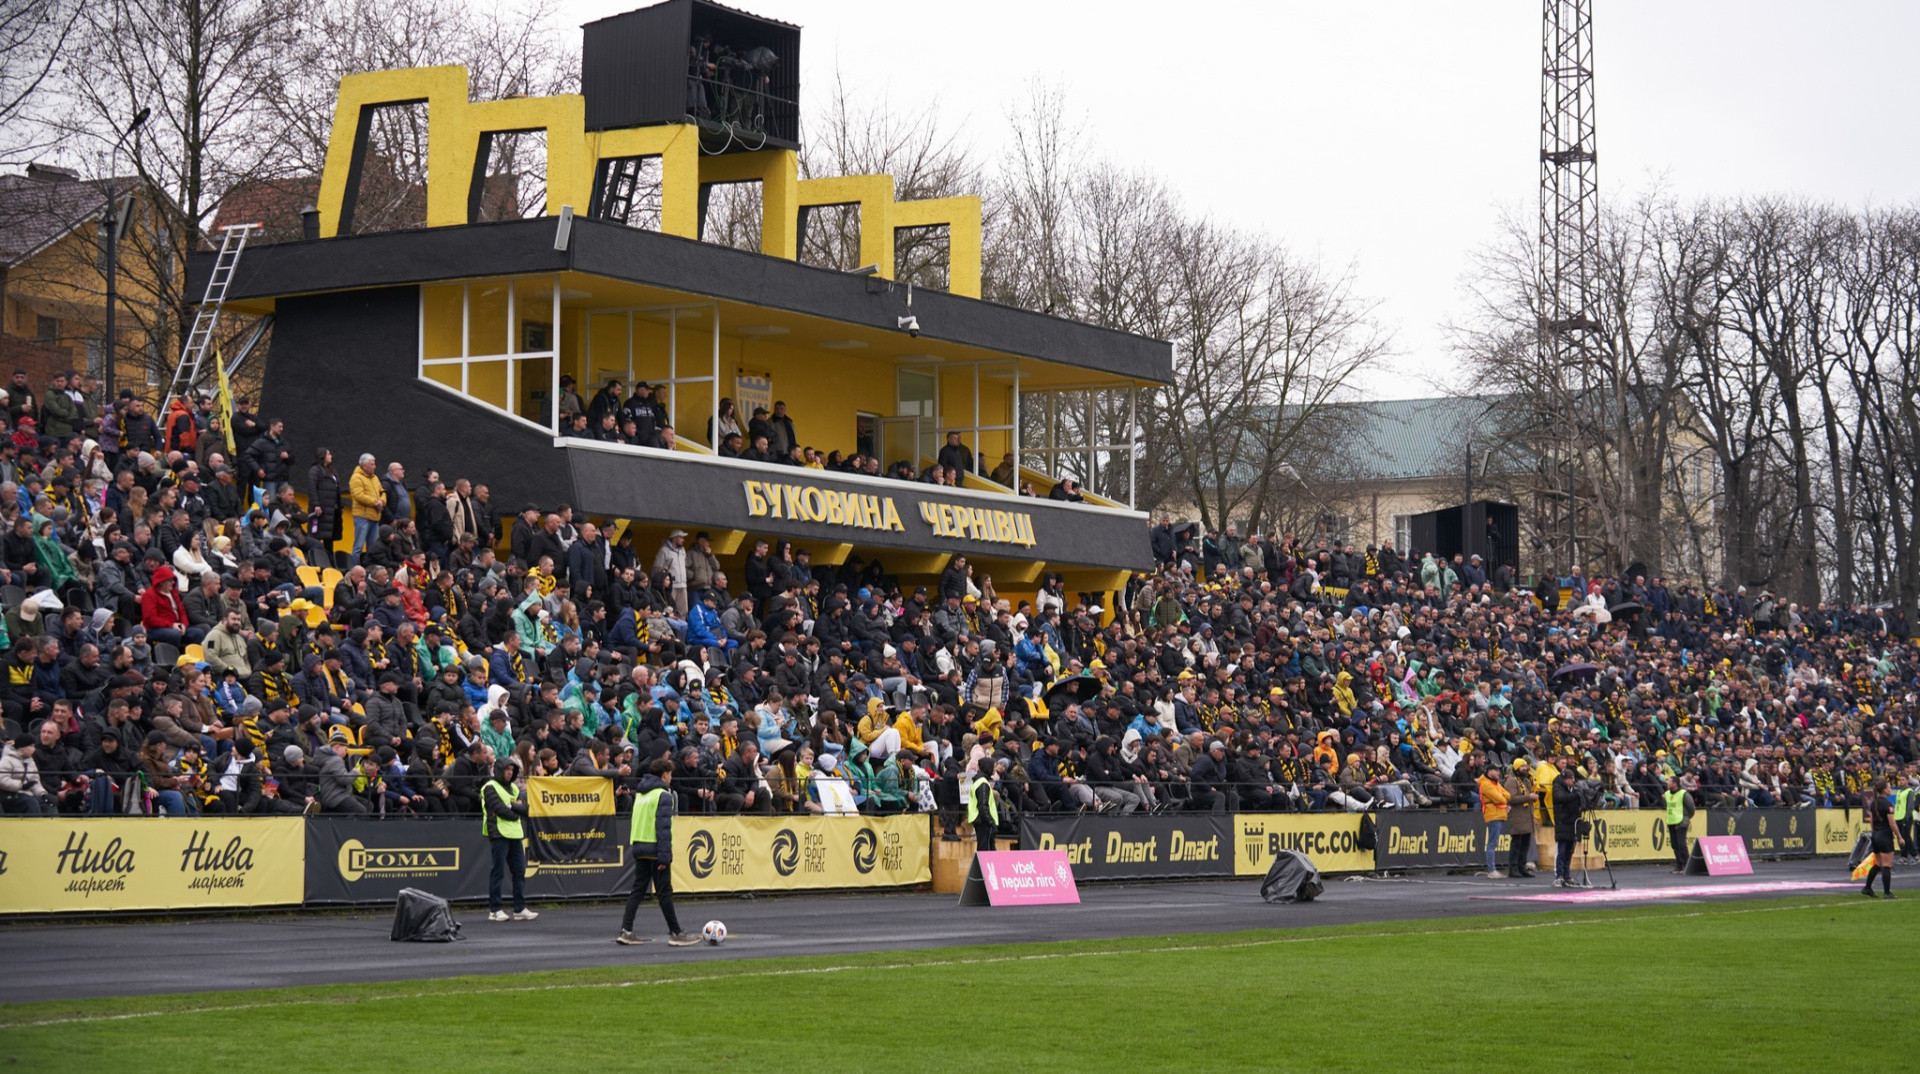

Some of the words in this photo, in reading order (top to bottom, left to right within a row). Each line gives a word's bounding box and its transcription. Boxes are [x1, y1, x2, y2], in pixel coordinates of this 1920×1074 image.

[742, 480, 905, 532] БУКОВИНА
[918, 501, 1037, 549] ЧЕРНІВЦІ
[541, 790, 600, 806] Буковина
[721, 832, 741, 848] Агро
[804, 831, 823, 846] Агро
[1105, 831, 1157, 863] Dmart
[1169, 830, 1219, 861] Dmart
[1388, 826, 1428, 854] Dmart
[1437, 826, 1476, 853] Dmart
[56, 831, 135, 874] Нива
[180, 830, 254, 872] Нива
[722, 848, 745, 863] Фрут
[804, 846, 826, 861] Фрут
[722, 861, 744, 875] Плюс
[804, 859, 825, 872] Плюс
[1012, 861, 1036, 874] vbet
[65, 874, 126, 898] маркет
[188, 872, 245, 894] маркет
[1001, 876, 1035, 892] перша
[1036, 873, 1056, 887] ліга
